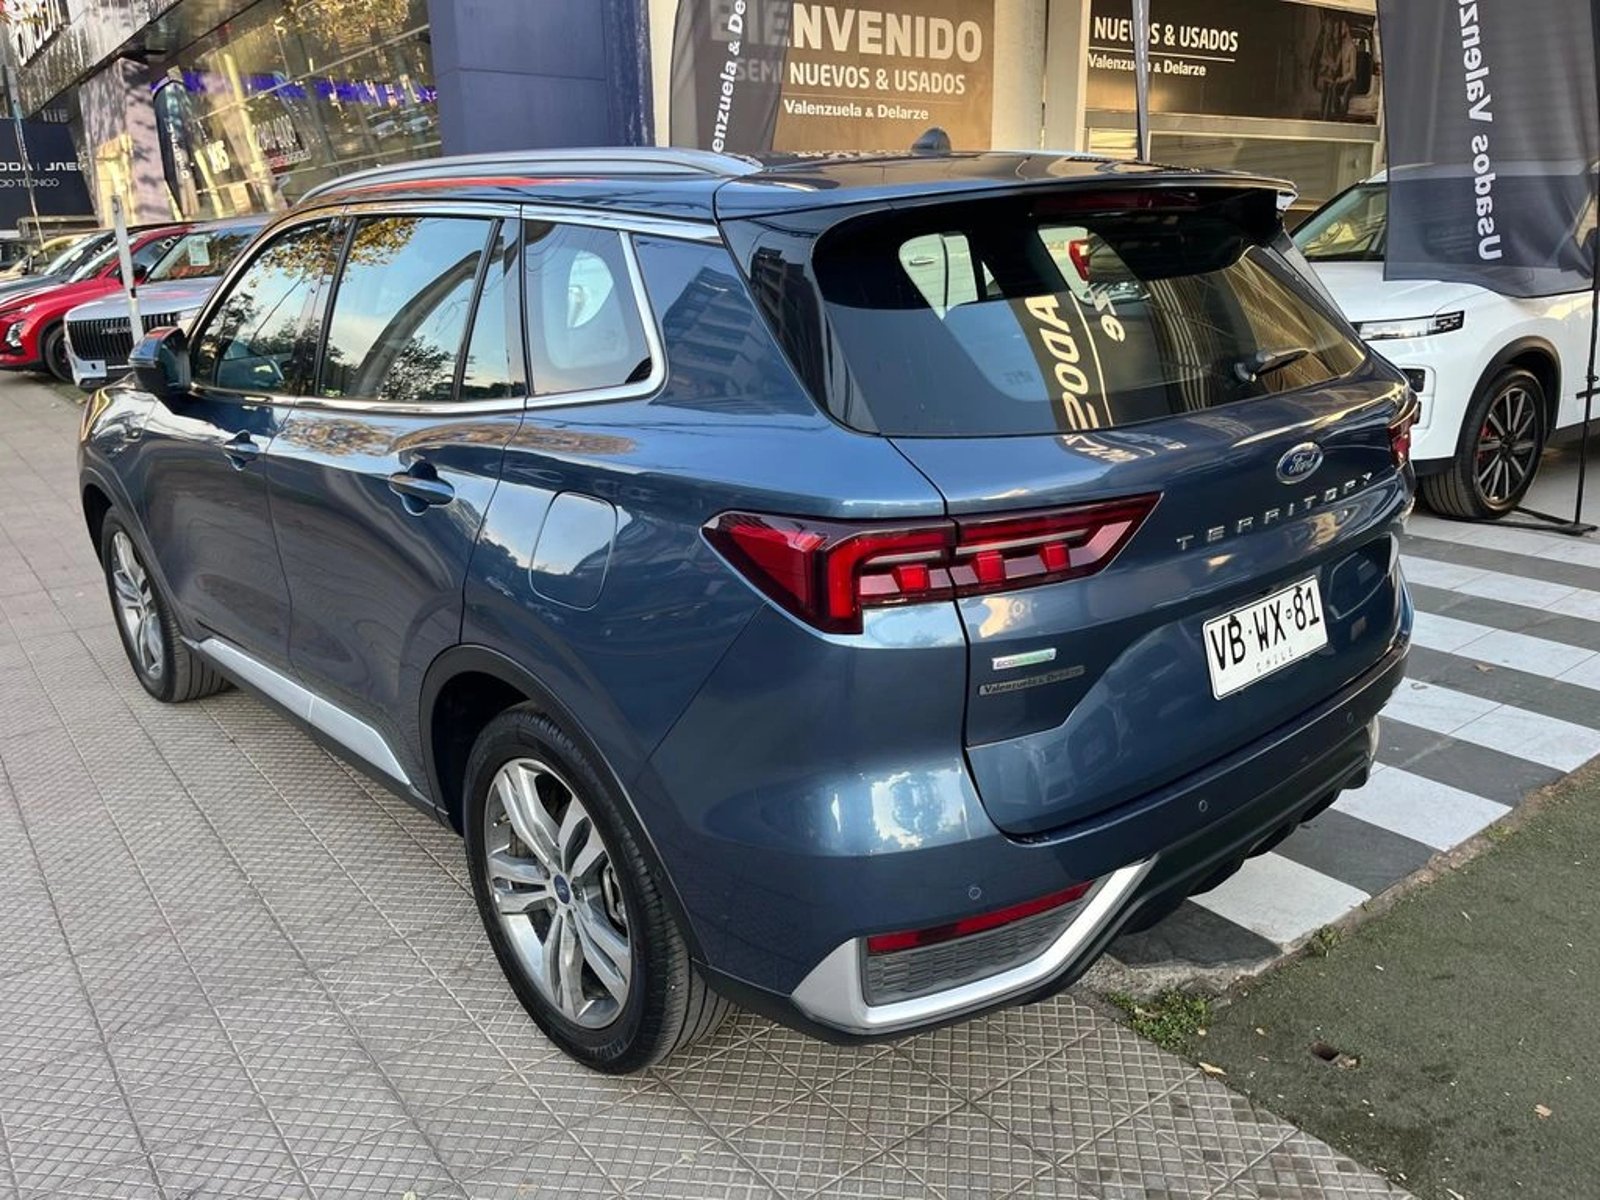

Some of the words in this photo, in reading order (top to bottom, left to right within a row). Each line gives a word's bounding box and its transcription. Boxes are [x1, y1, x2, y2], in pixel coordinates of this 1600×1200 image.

[728, 40, 741, 56] &
[1094, 16, 1160, 45] NUES
[1163, 24, 1176, 47] &
[1179, 25, 1239, 52] USADOS
[789, 62, 870, 90] NUEVOS
[875, 68, 889, 91] &
[894, 69, 966, 95] USADOS
[1088, 53, 1151, 73] Valenzu
[1153, 62, 1161, 73] &
[1163, 59, 1206, 77] Delarze
[783, 99, 862, 118] Valenzuela
[865, 106, 874, 118] &
[877, 103, 929, 120] Delarze
[1176, 472, 1373, 550] TERRITORY
